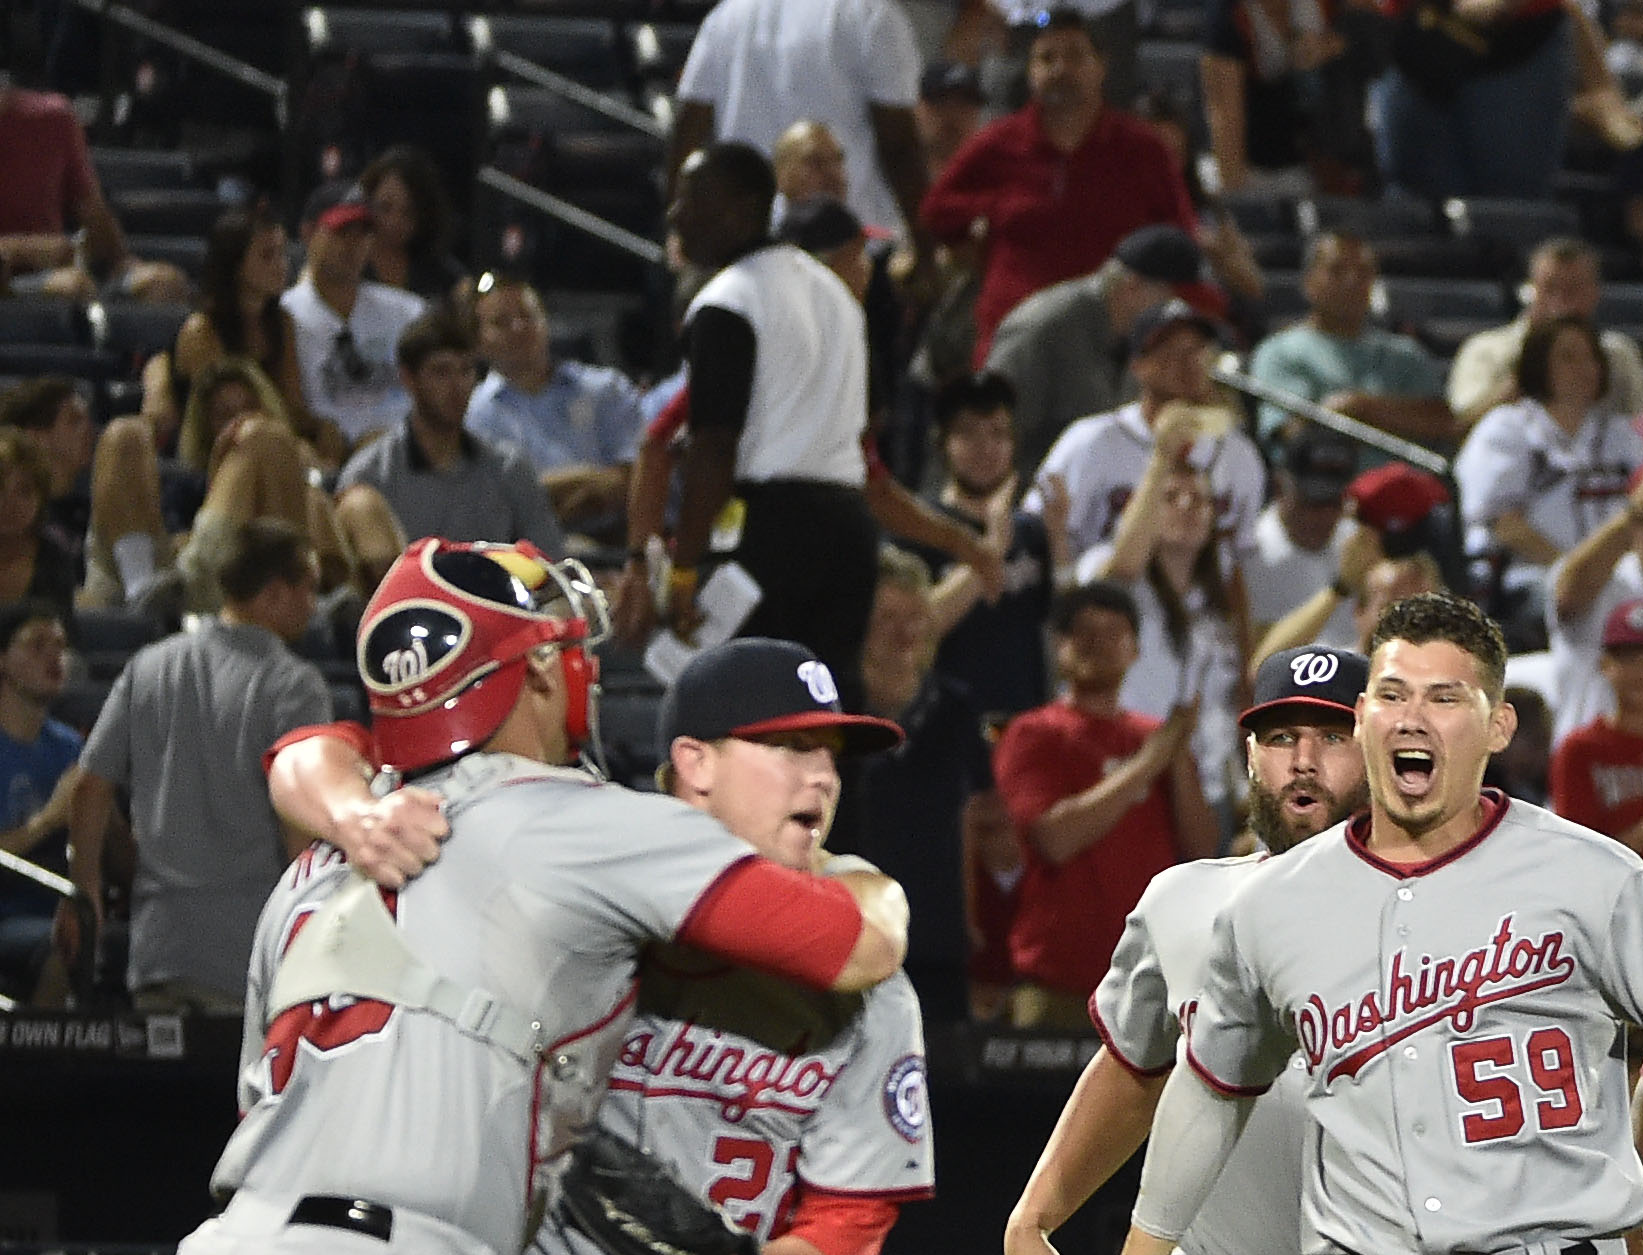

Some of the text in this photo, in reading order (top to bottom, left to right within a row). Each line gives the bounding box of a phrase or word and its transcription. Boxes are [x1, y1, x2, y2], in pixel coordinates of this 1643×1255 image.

[1291, 653, 1338, 685] W
[1296, 912, 1576, 1084] Washington
[1450, 1026, 1583, 1147] 59
